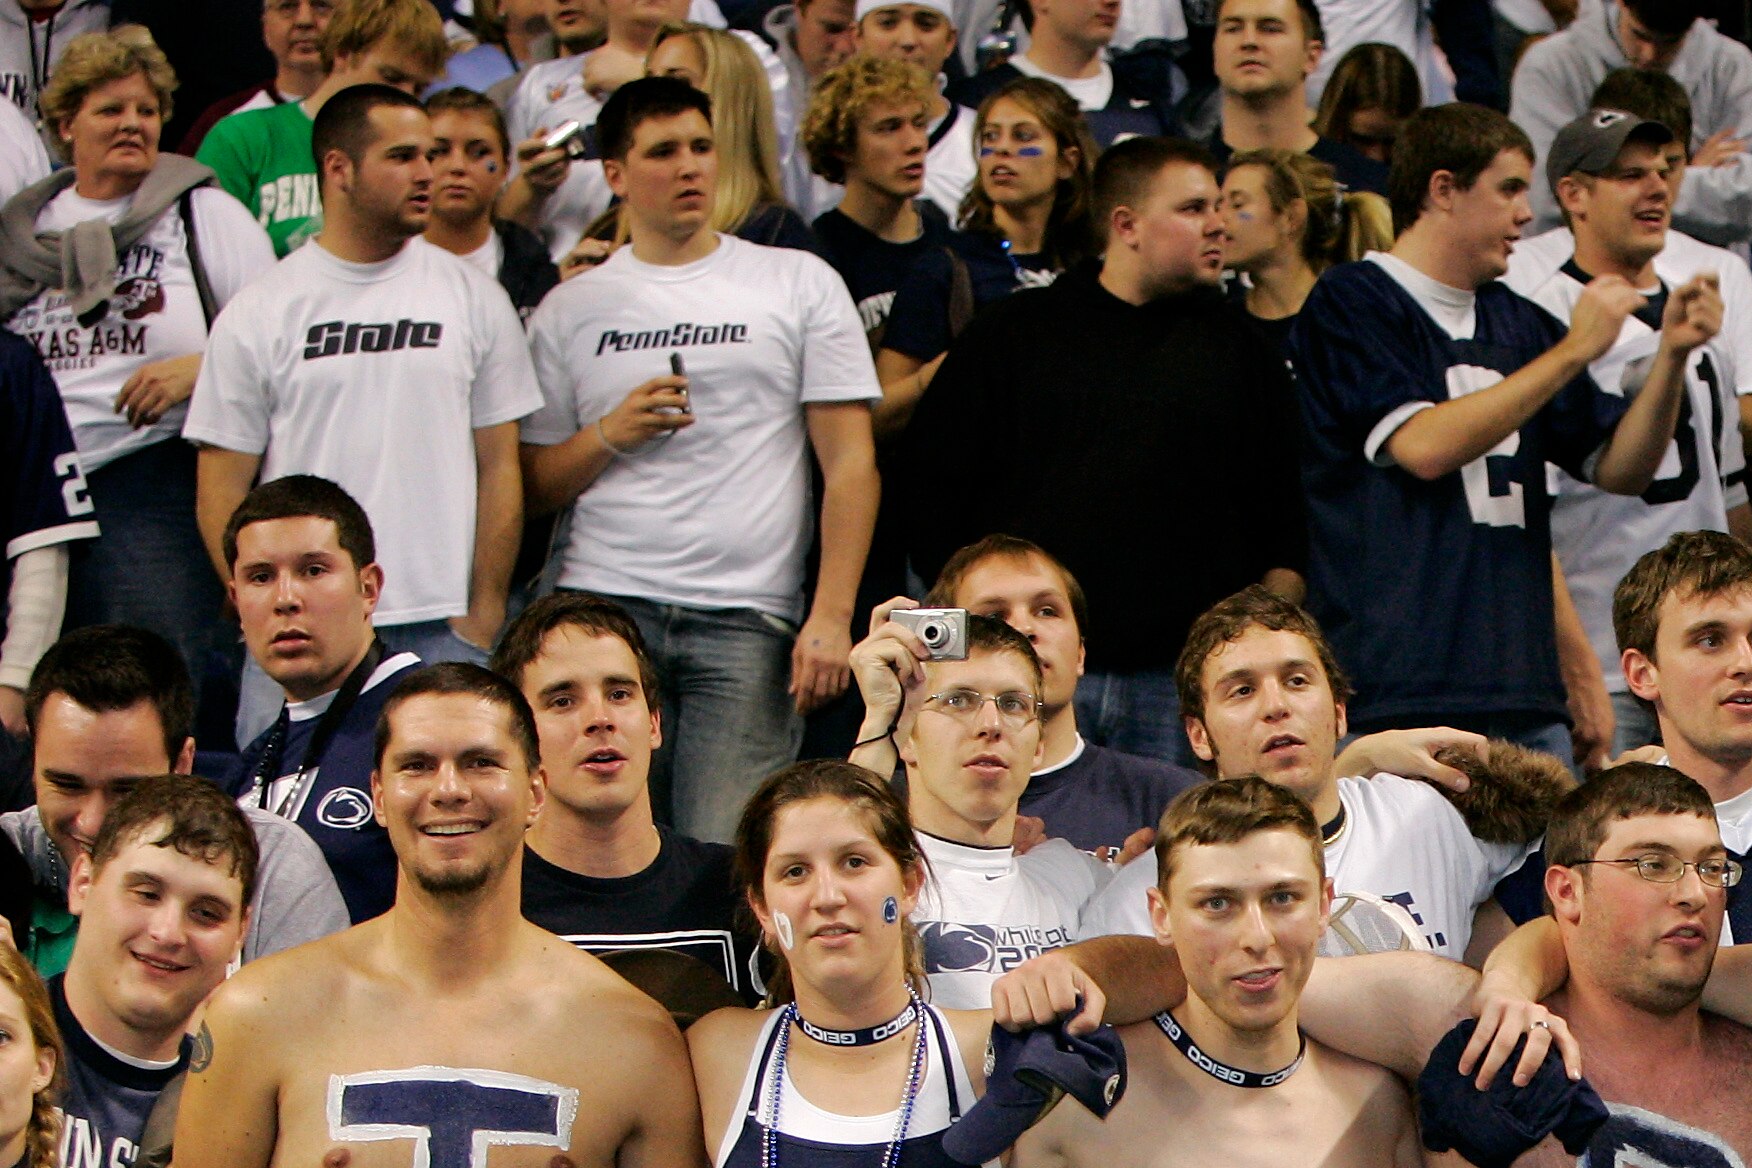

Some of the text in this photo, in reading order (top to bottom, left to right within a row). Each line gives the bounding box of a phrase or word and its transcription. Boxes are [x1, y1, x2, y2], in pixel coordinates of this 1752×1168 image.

[303, 318, 443, 360] State
[595, 323, 750, 356] PennState
[53, 451, 95, 518] 2
[803, 1005, 917, 1045] GEICO GEICO
[1186, 1044, 1246, 1085] GEICO
